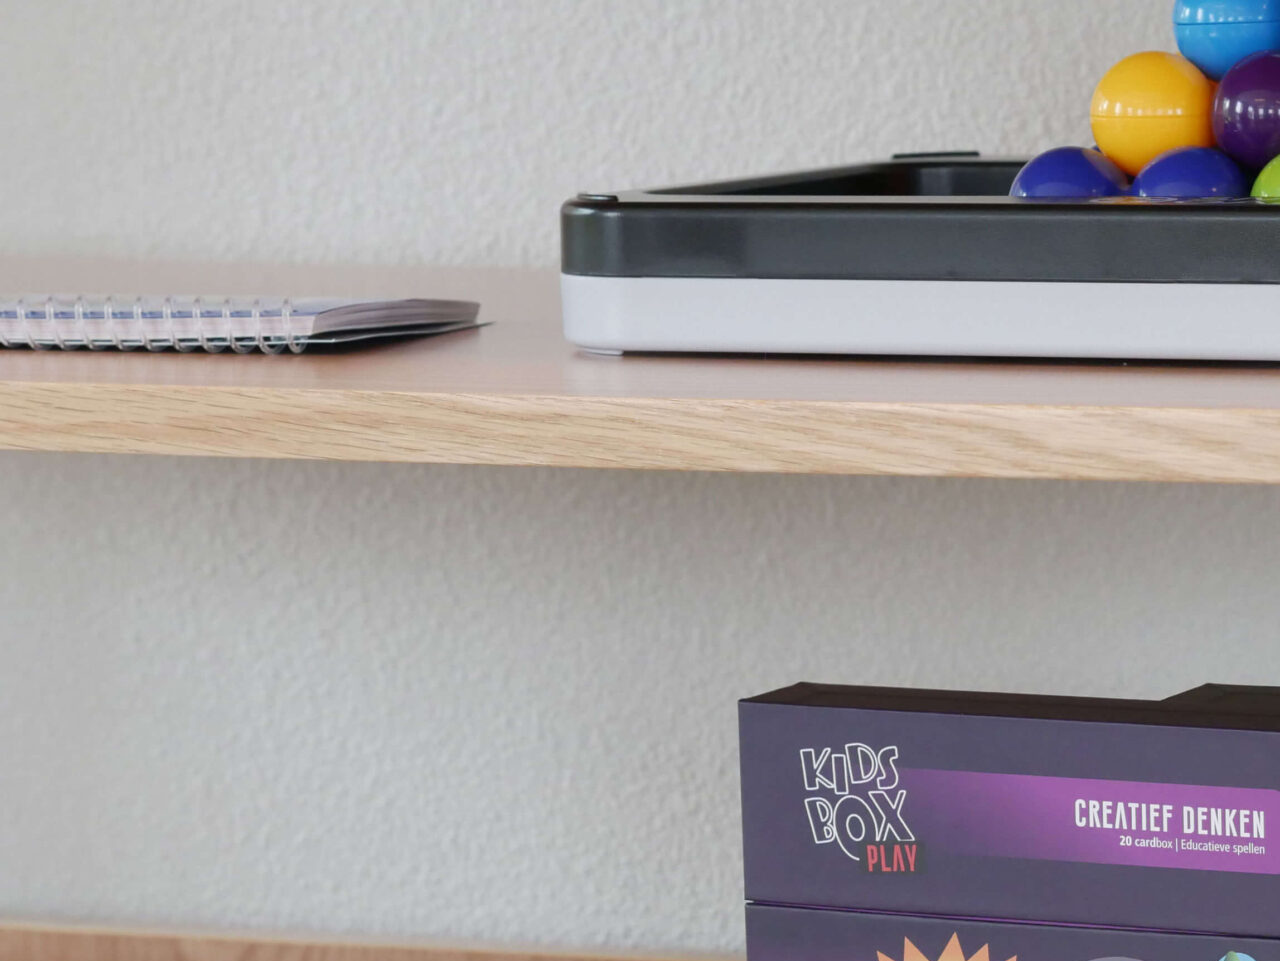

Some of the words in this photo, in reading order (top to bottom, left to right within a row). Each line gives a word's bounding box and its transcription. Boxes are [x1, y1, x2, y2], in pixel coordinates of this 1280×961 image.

[800, 743, 898, 794] KIDS
[804, 790, 915, 861] BOX
[1074, 798, 1173, 833] CREATIEF
[1182, 805, 1265, 839] DENKEN
[866, 844, 917, 872] PLAY
[1119, 835, 1132, 847] 20
[1134, 836, 1173, 849] cardbox
[1181, 839, 1231, 853] Educatieve
[1232, 842, 1266, 856] spellen
